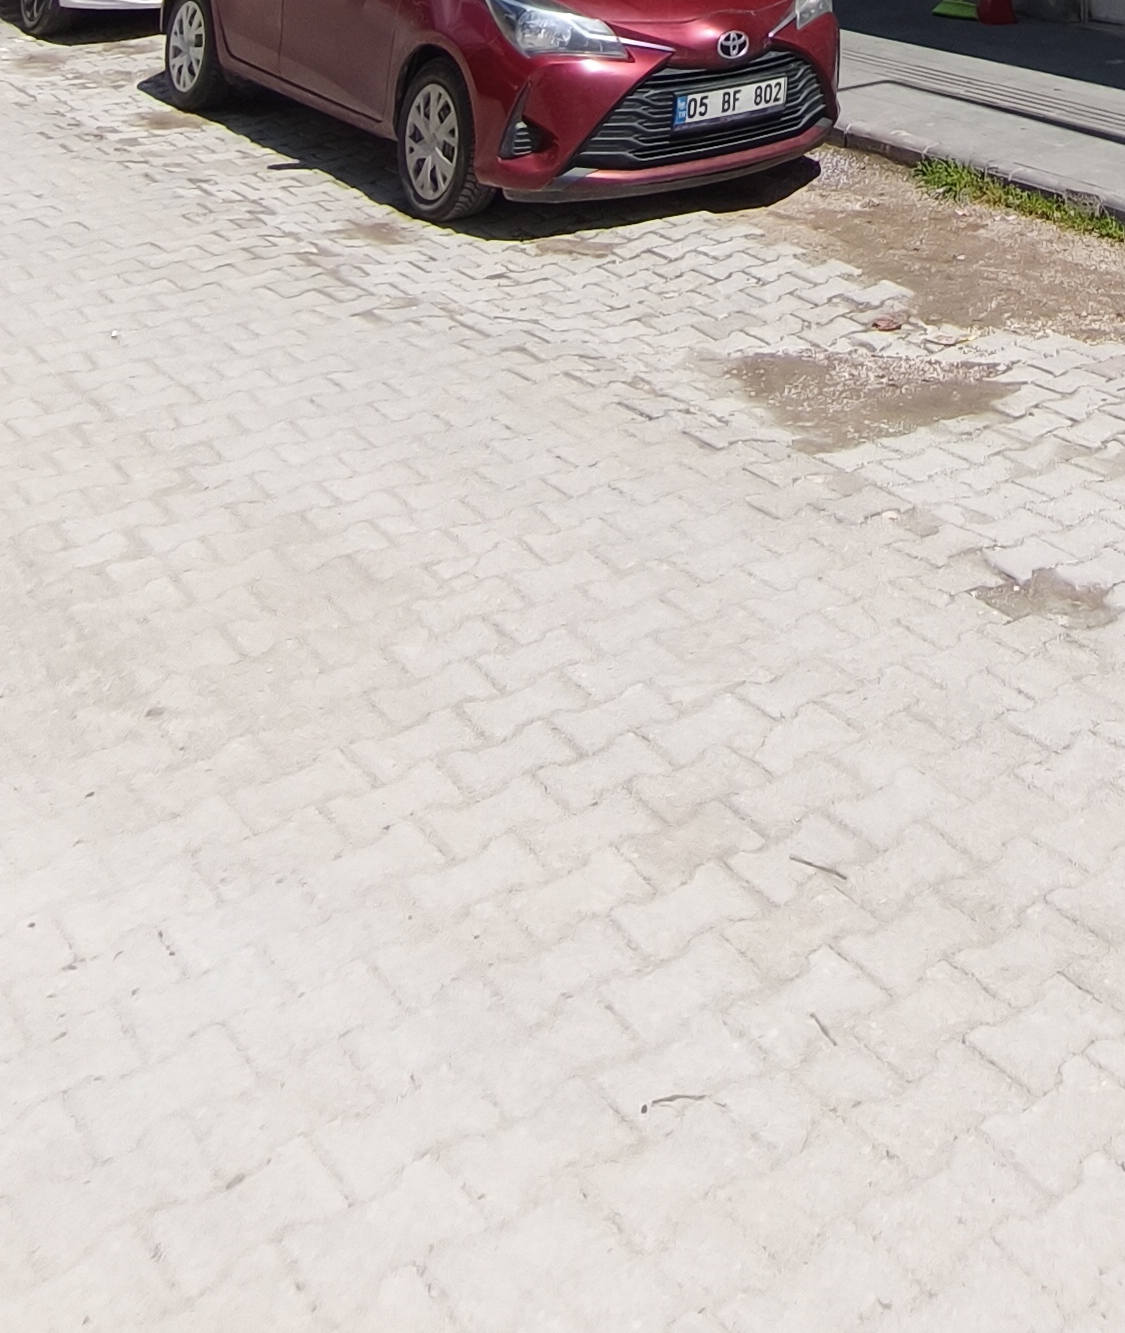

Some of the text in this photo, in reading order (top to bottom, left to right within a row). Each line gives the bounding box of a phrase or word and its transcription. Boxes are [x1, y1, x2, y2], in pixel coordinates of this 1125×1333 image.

[687, 82, 782, 118] 05 BF 802
